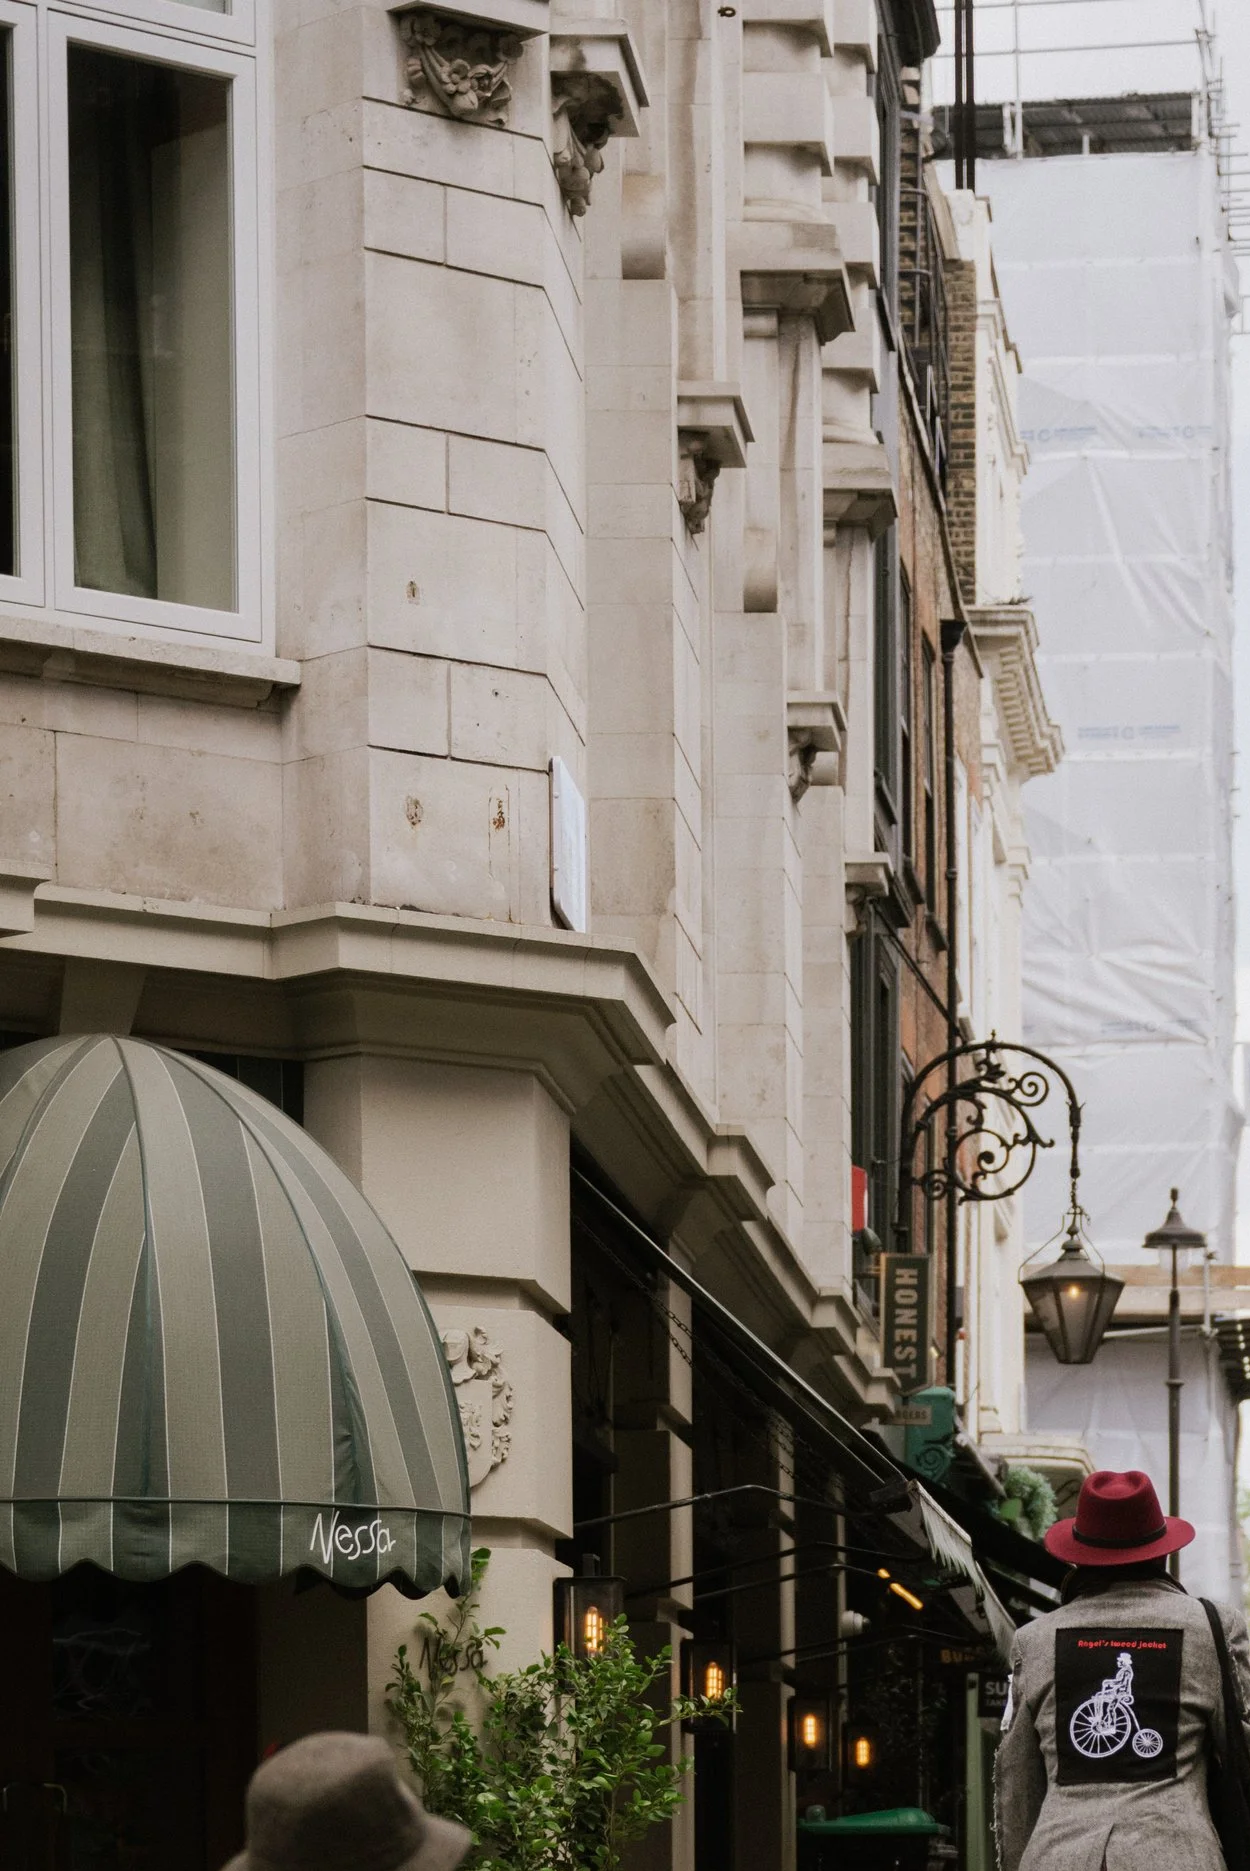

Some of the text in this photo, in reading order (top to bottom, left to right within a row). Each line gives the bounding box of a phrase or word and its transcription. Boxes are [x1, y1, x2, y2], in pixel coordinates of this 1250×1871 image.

[894, 1268, 918, 1379] HONEST
[309, 1511, 397, 1564] Nessa
[1110, 1640, 1137, 1648] tweed
[1137, 1640, 1167, 1650] jacket
